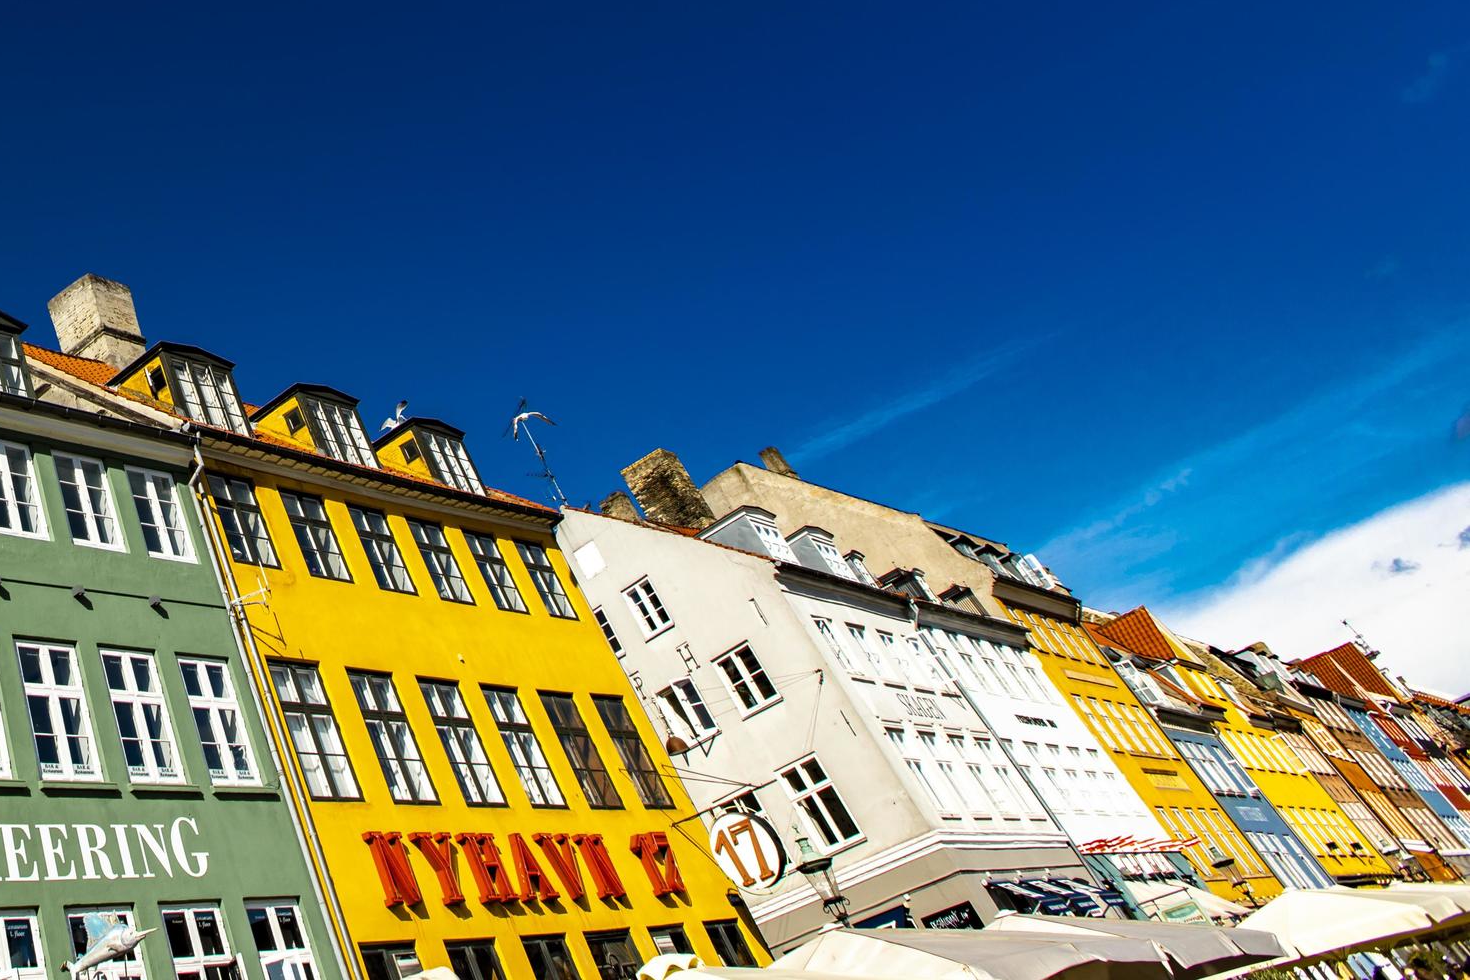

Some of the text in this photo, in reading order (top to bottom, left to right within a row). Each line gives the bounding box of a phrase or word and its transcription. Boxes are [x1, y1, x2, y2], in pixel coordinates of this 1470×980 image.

[896, 692, 947, 721] SKAGEN
[362, 831, 686, 907] NYHAVN 17
[715, 817, 775, 887] 17
